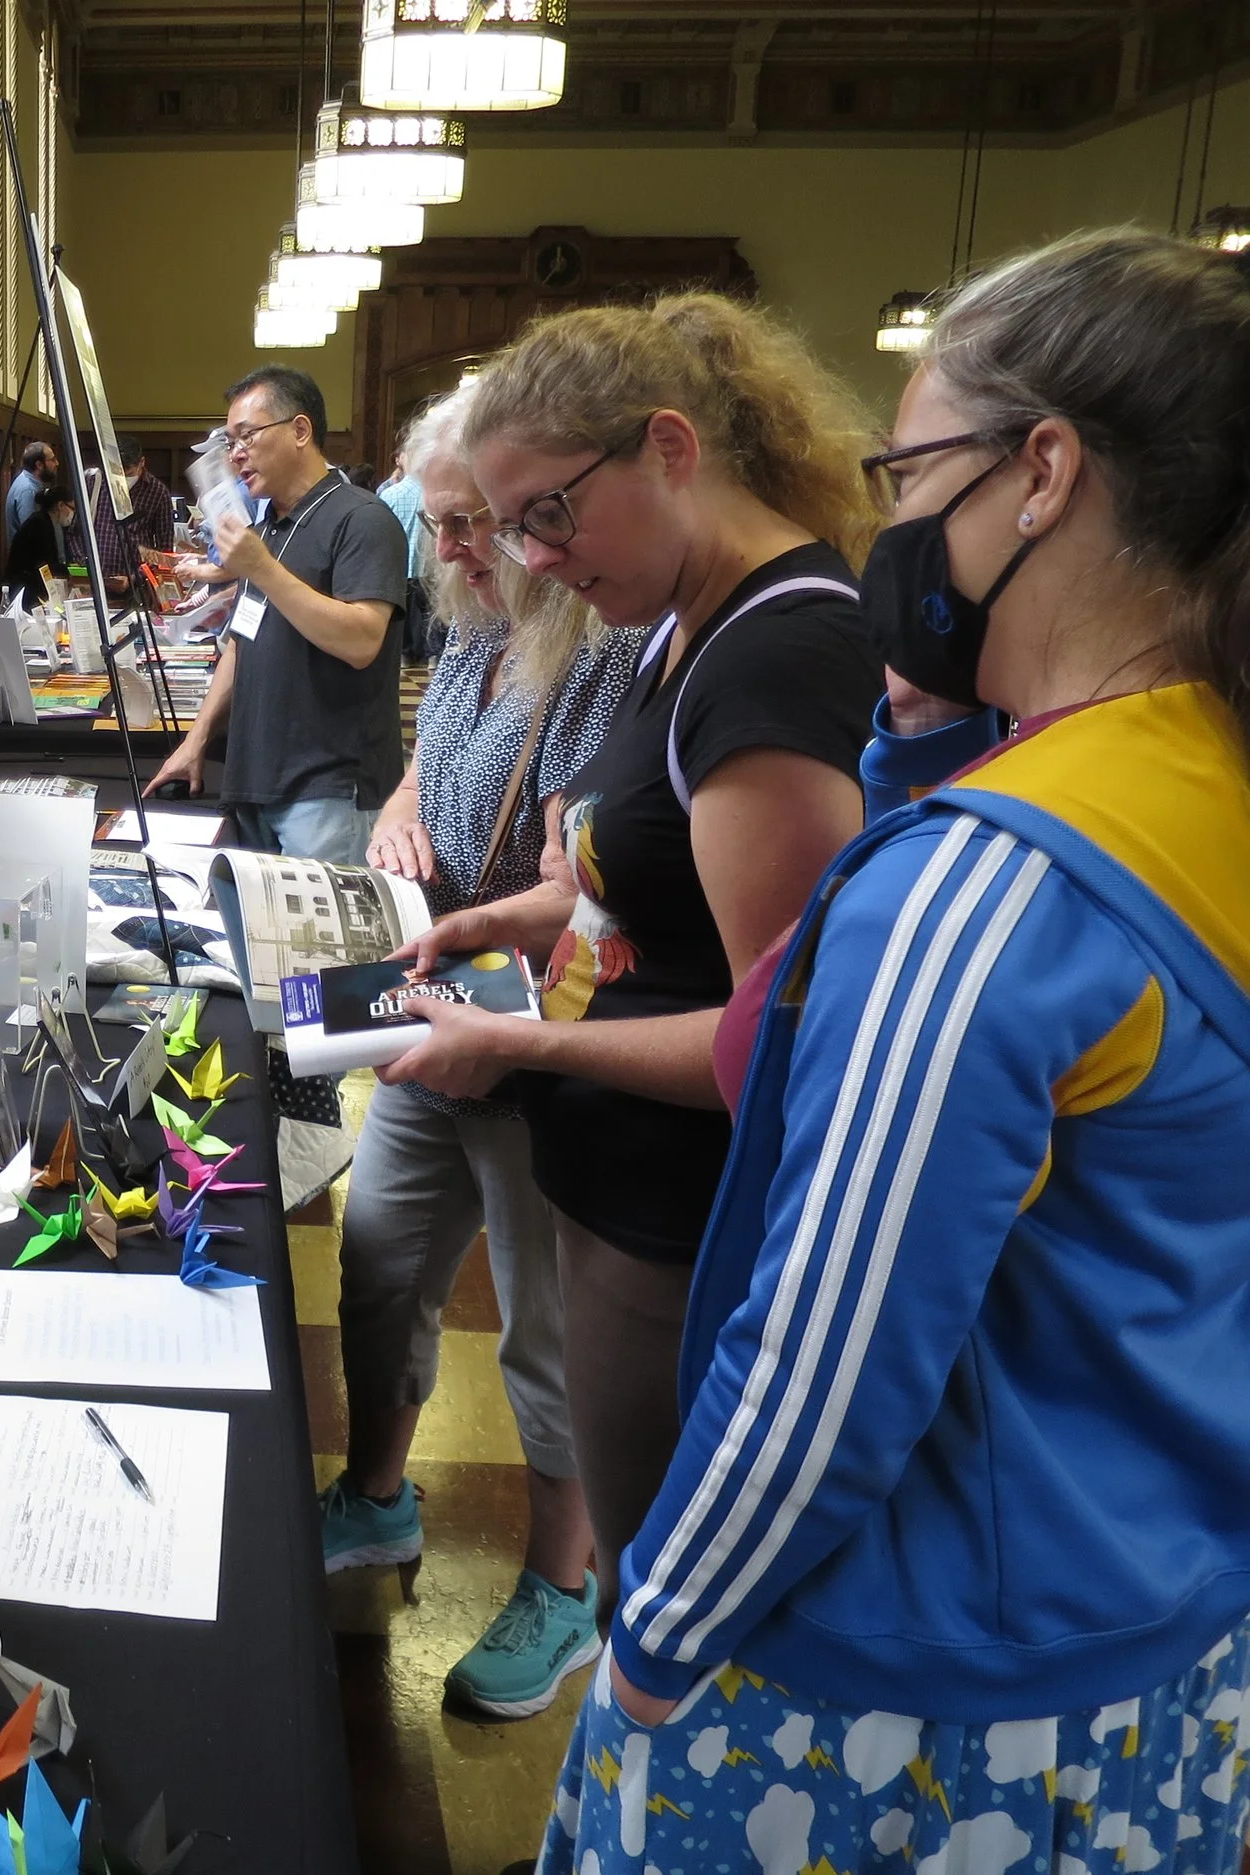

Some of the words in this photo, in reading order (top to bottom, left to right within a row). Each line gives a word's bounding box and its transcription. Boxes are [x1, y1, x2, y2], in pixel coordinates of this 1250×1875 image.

[369, 989, 476, 1017] OURY
[378, 991, 388, 1002] A
[395, 982, 465, 999] REBEL'S
